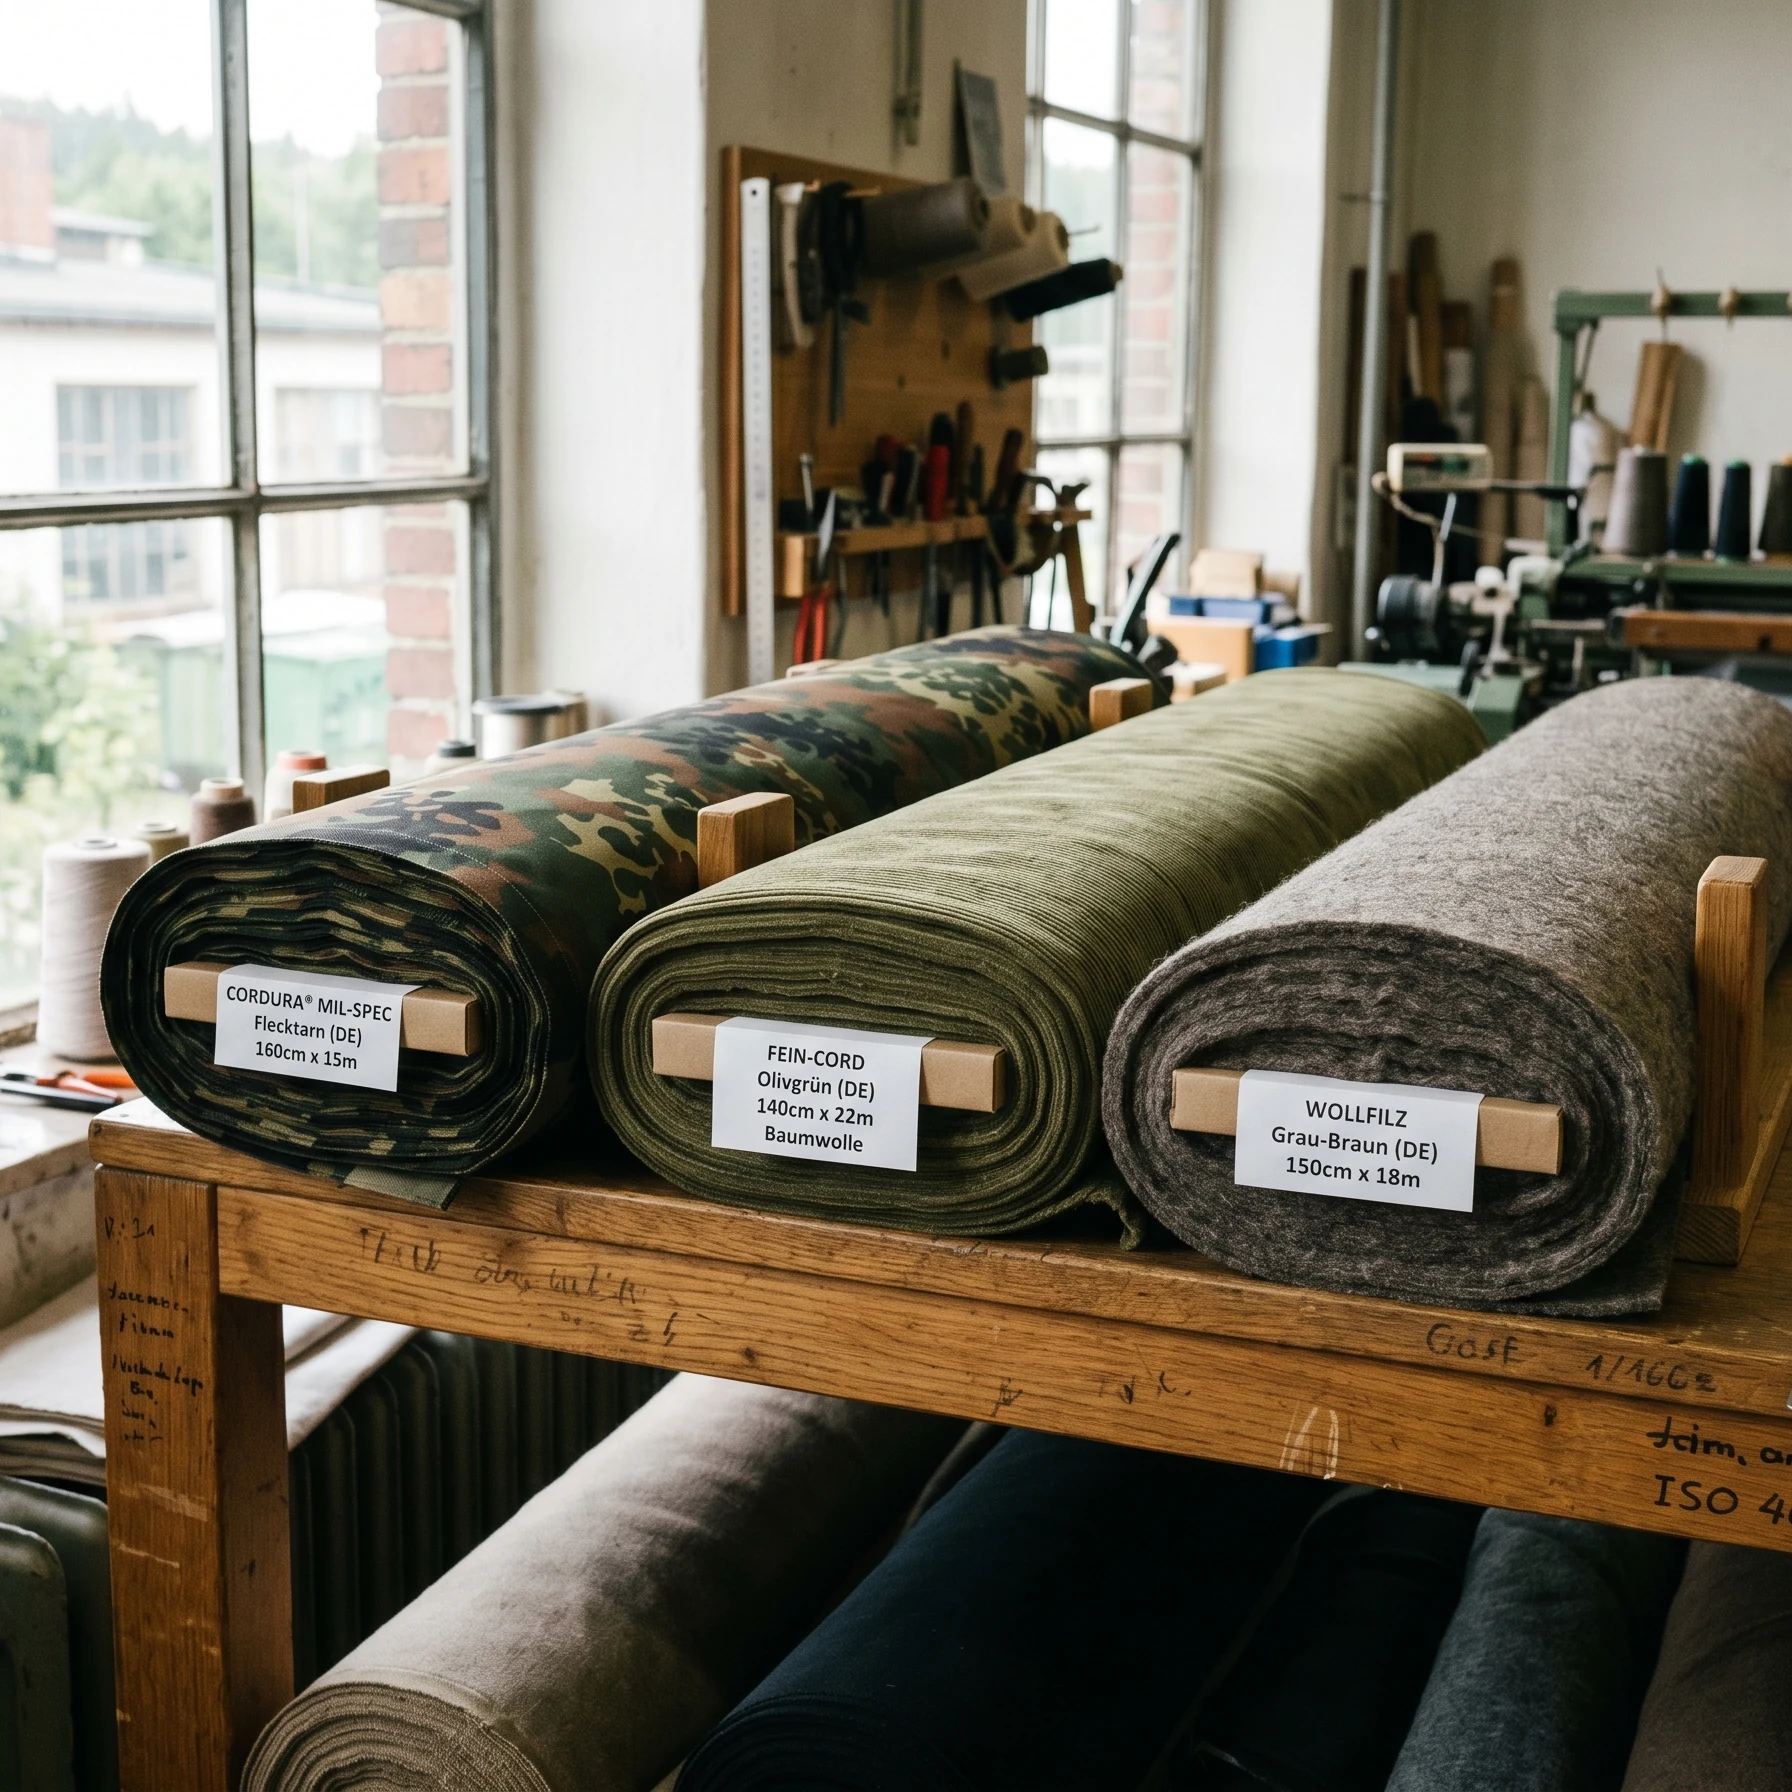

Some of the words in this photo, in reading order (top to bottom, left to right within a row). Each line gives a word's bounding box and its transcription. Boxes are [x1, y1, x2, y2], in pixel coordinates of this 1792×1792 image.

[227, 986, 313, 1010] CORDURA®
[318, 998, 392, 1022] MIL-SPEC
[254, 1015, 325, 1039] Flecktarn
[330, 1024, 362, 1048] (DE)
[255, 1041, 306, 1062] 160cm
[310, 1052, 319, 1064] x
[324, 1051, 357, 1069] 15m
[767, 1045, 865, 1070] FEIN-CORD
[757, 1071, 832, 1095] Olivgrün
[837, 1079, 875, 1103] (DE)
[757, 1097, 814, 1120] 140cm
[819, 1109, 829, 1122] x
[834, 1107, 873, 1126] 22m
[1306, 1100, 1408, 1128] WOLLFILZ
[765, 1125, 863, 1152] Baumwolle
[1271, 1126, 1388, 1155] Grau-Braun
[1395, 1139, 1438, 1165] (DE)
[1286, 1156, 1351, 1180] 150cm
[1358, 1168, 1369, 1182] x
[1376, 1167, 1420, 1188] 18m
[1654, 1474, 1739, 1515] ISO
[1758, 1492, 1792, 1525] 4
